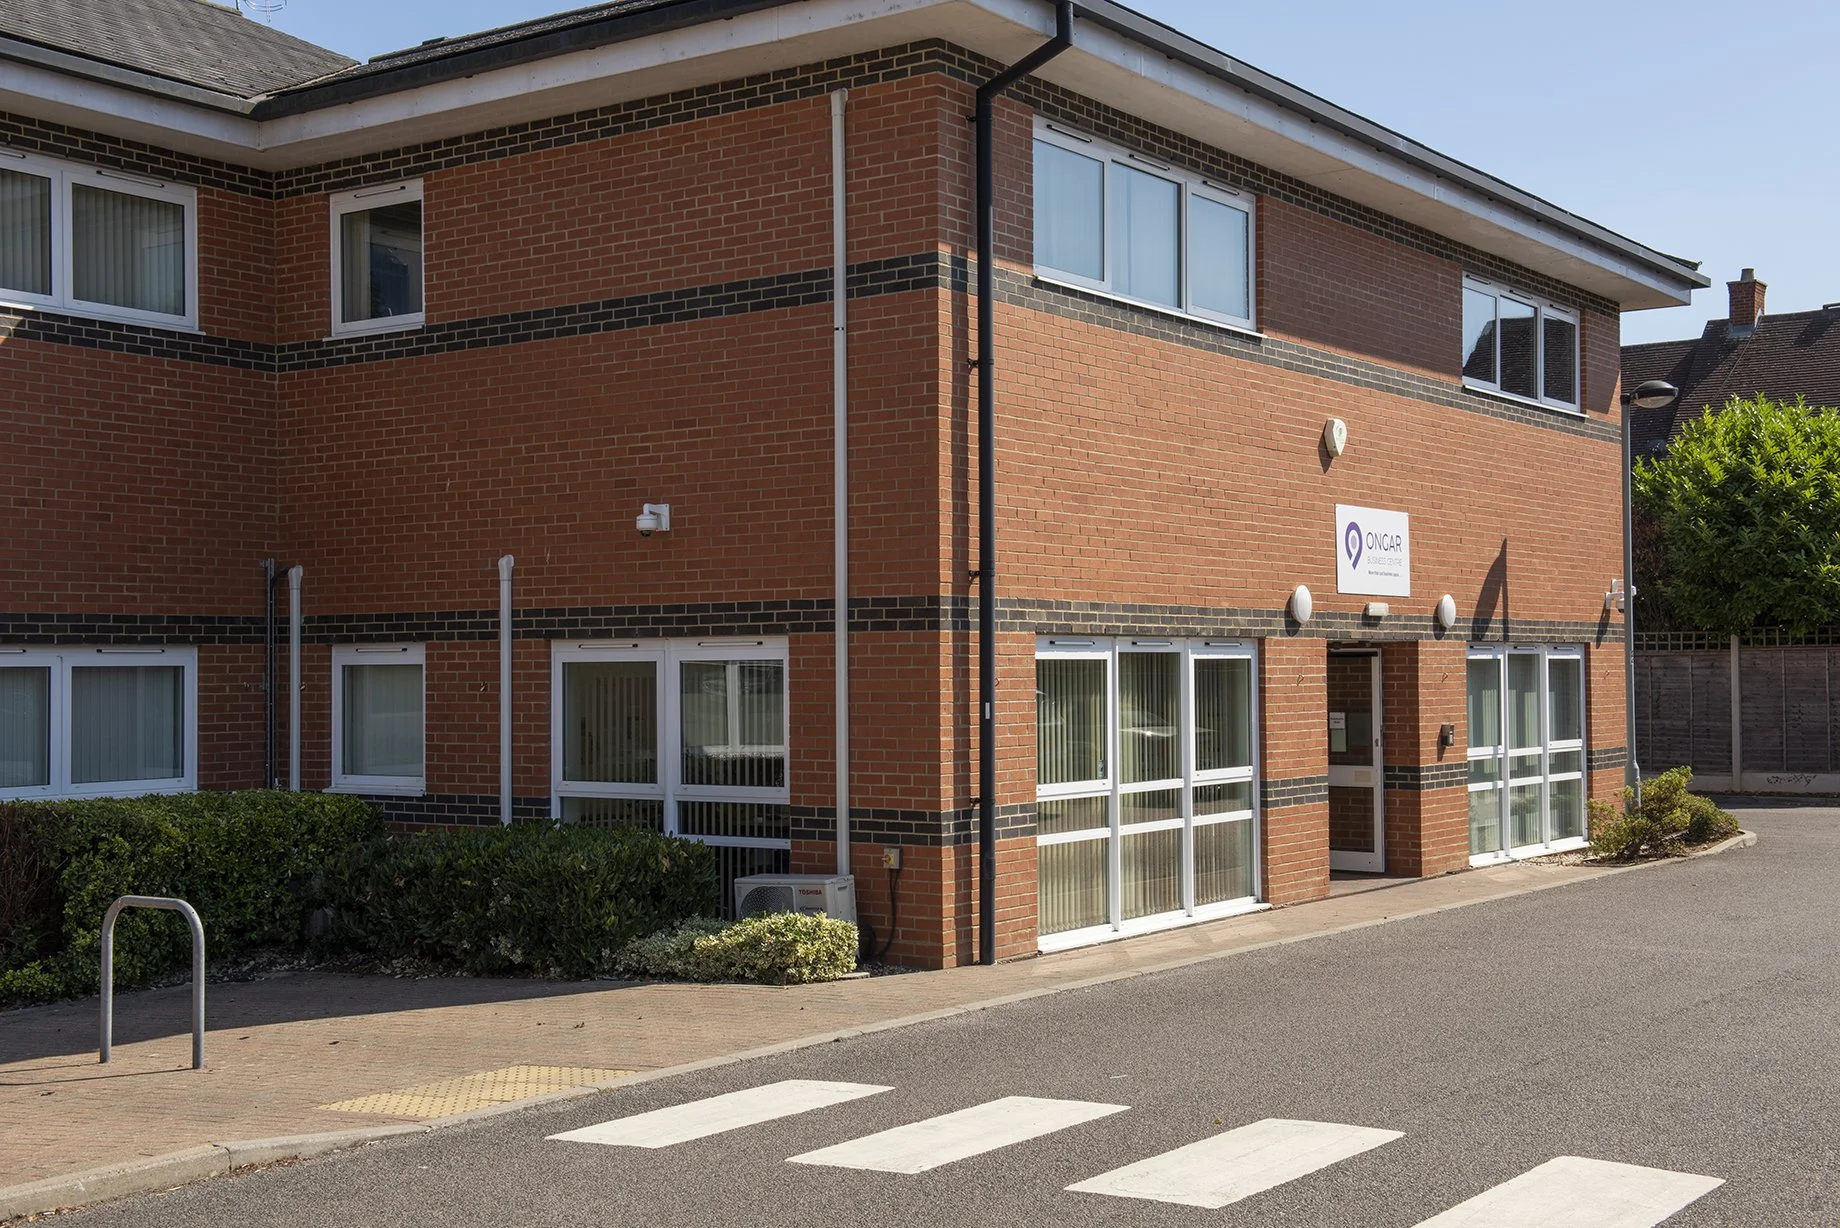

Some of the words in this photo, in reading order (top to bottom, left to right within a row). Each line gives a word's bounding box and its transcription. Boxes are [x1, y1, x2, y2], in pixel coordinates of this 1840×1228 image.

[1366, 532, 1402, 552] ONGAR
[1367, 555, 1386, 565] BUSINESS
[1387, 557, 1402, 566] CENTRE
